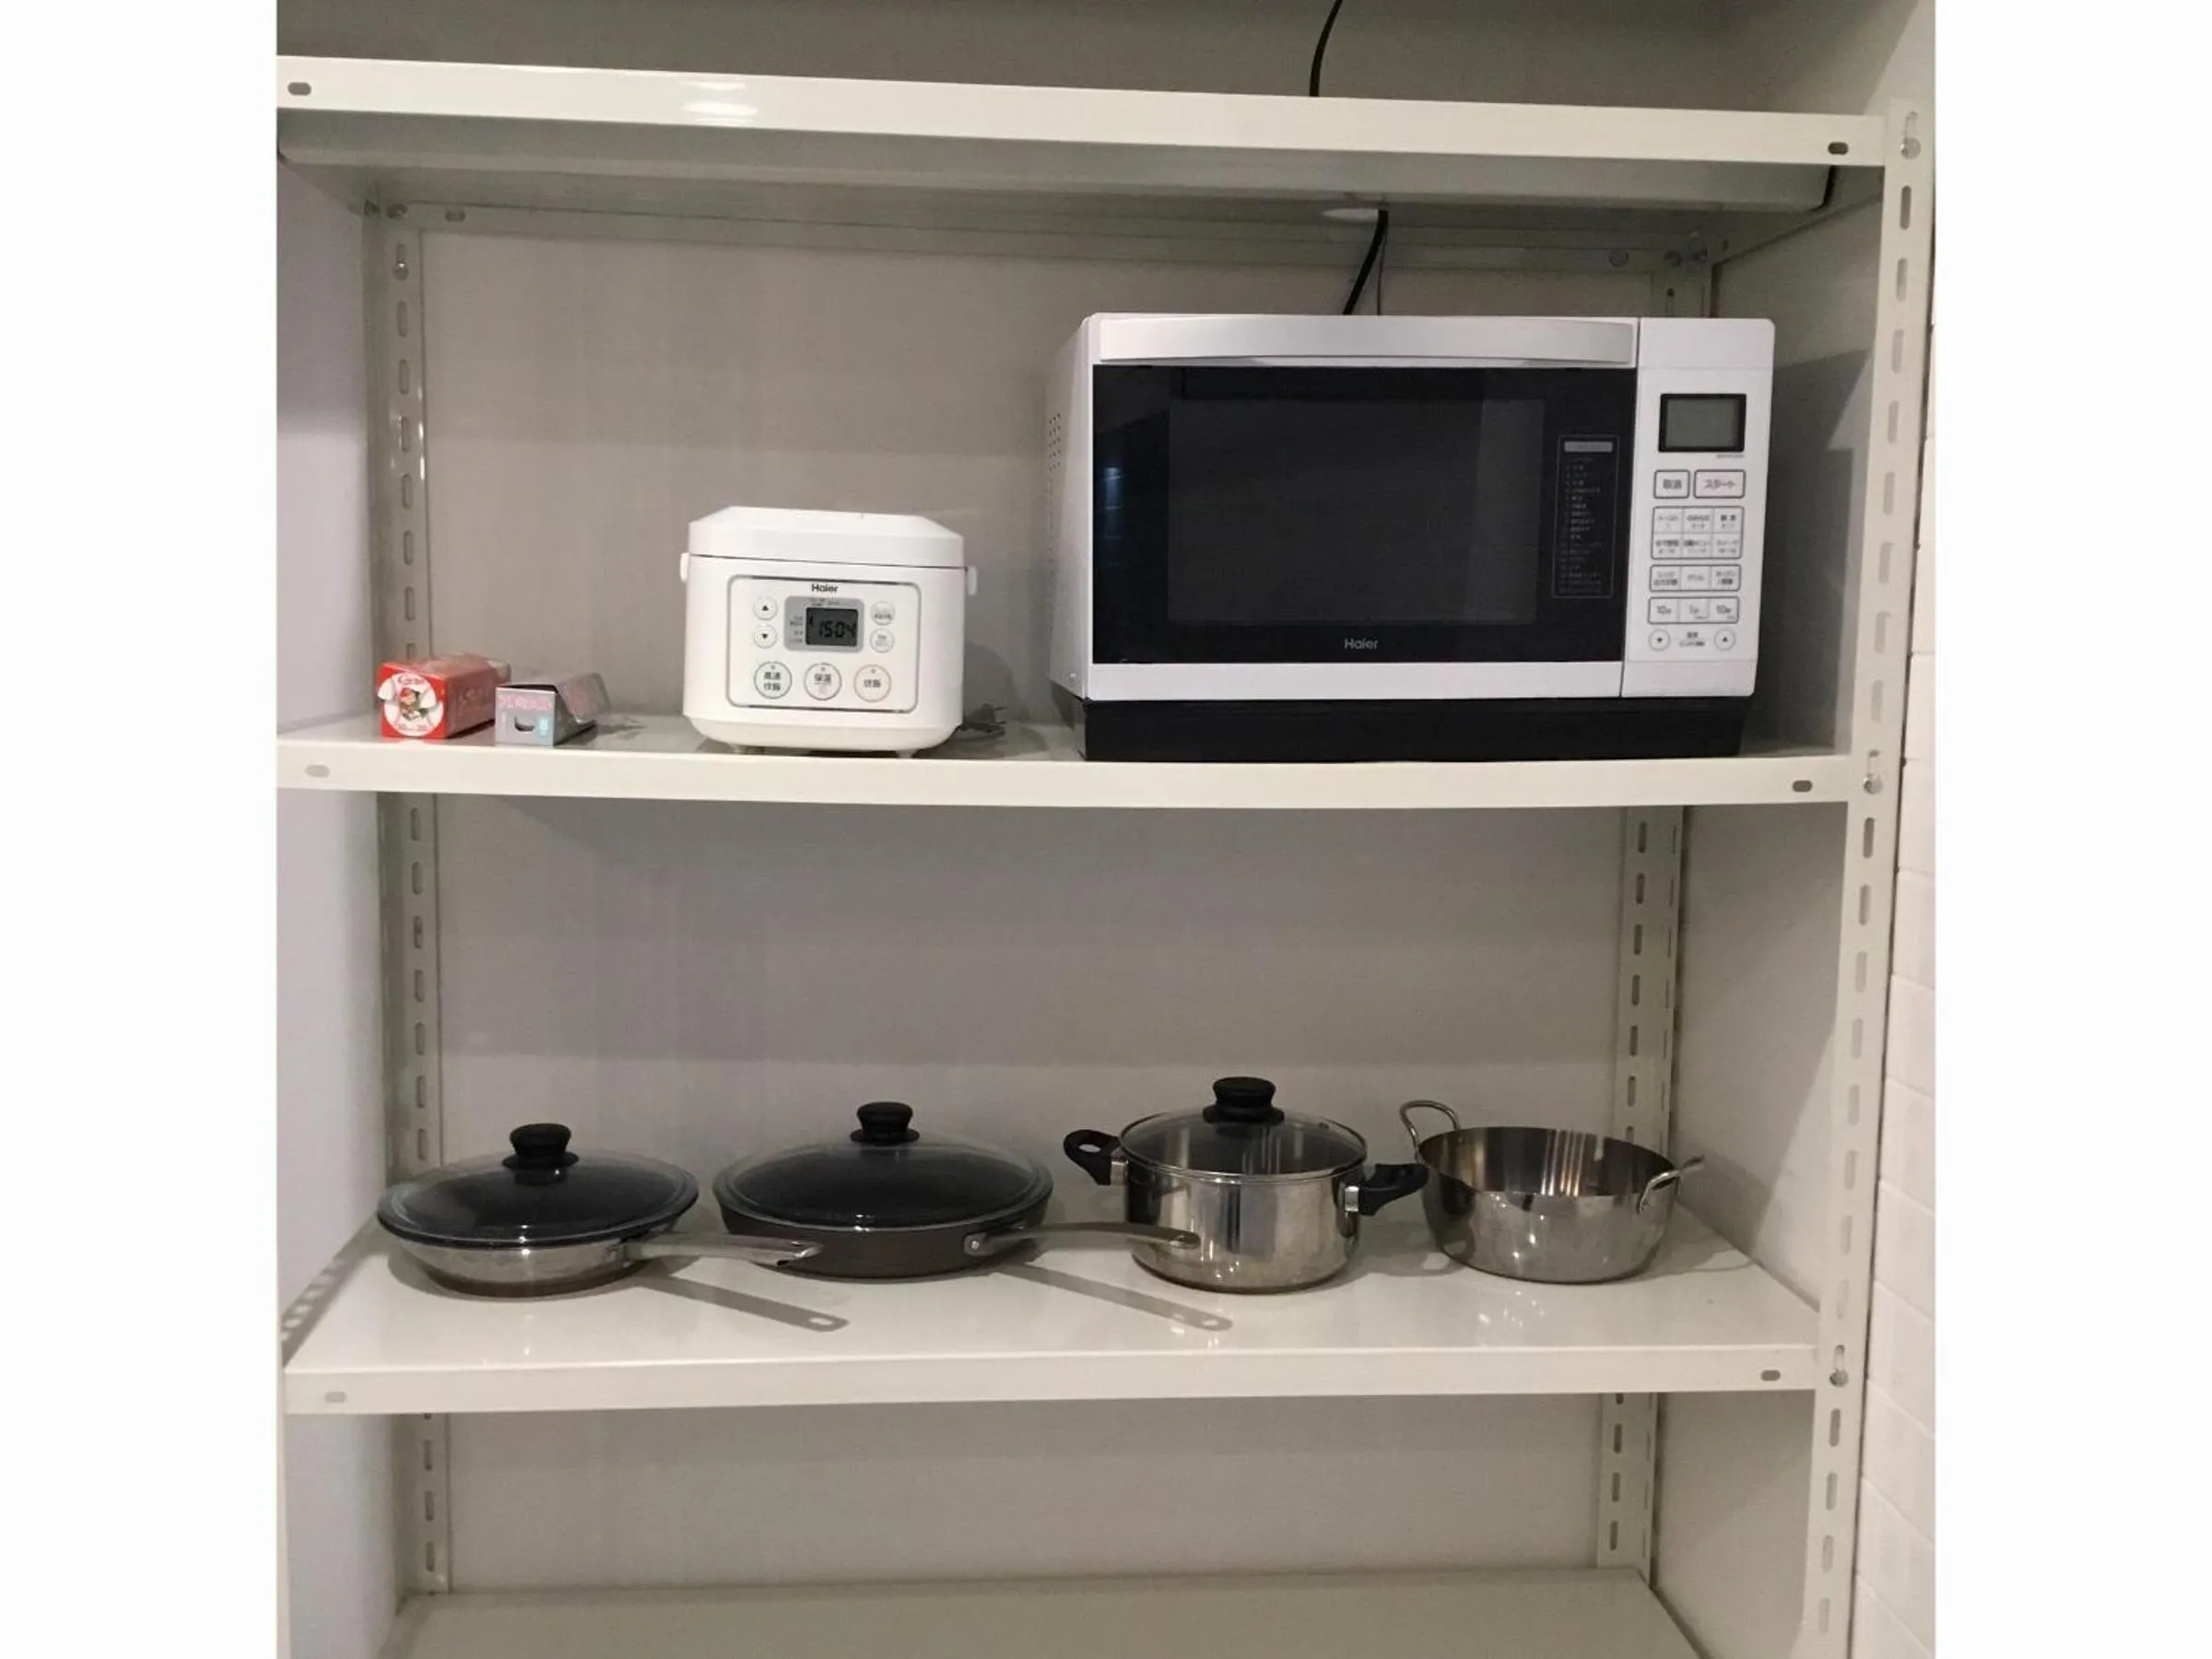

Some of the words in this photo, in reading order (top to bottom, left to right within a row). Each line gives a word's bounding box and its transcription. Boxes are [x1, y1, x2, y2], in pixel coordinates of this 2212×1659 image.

[1704, 478, 1736, 490] スタート
[811, 583, 839, 593] Haier
[1344, 637, 1379, 650] Haier
